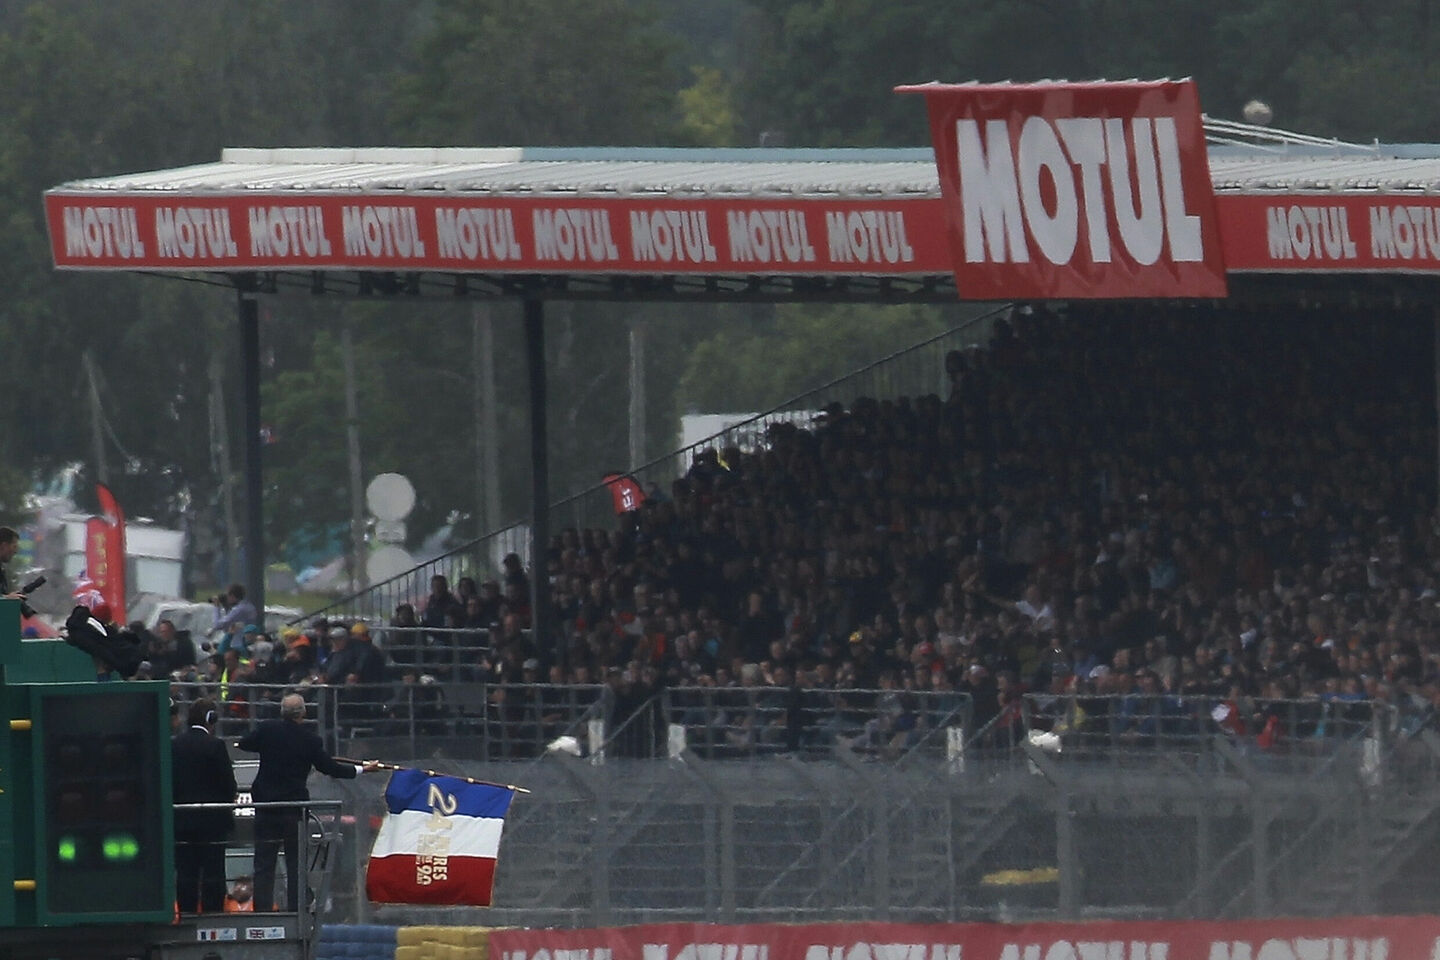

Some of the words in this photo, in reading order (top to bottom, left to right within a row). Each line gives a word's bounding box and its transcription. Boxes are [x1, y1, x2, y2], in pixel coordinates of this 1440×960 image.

[956, 116, 1203, 266] MOTUL
[63, 206, 145, 259] MOTUL
[155, 206, 238, 259] MOTUL
[248, 206, 332, 258] MOTUL
[341, 206, 425, 259] MOTUL
[435, 207, 522, 260] MOTUL
[532, 208, 619, 262] MOTUL
[629, 209, 717, 263] MOTUL
[726, 209, 816, 263] MOTUL
[825, 210, 915, 264] MOTUL
[1266, 204, 1357, 260] MOTUL
